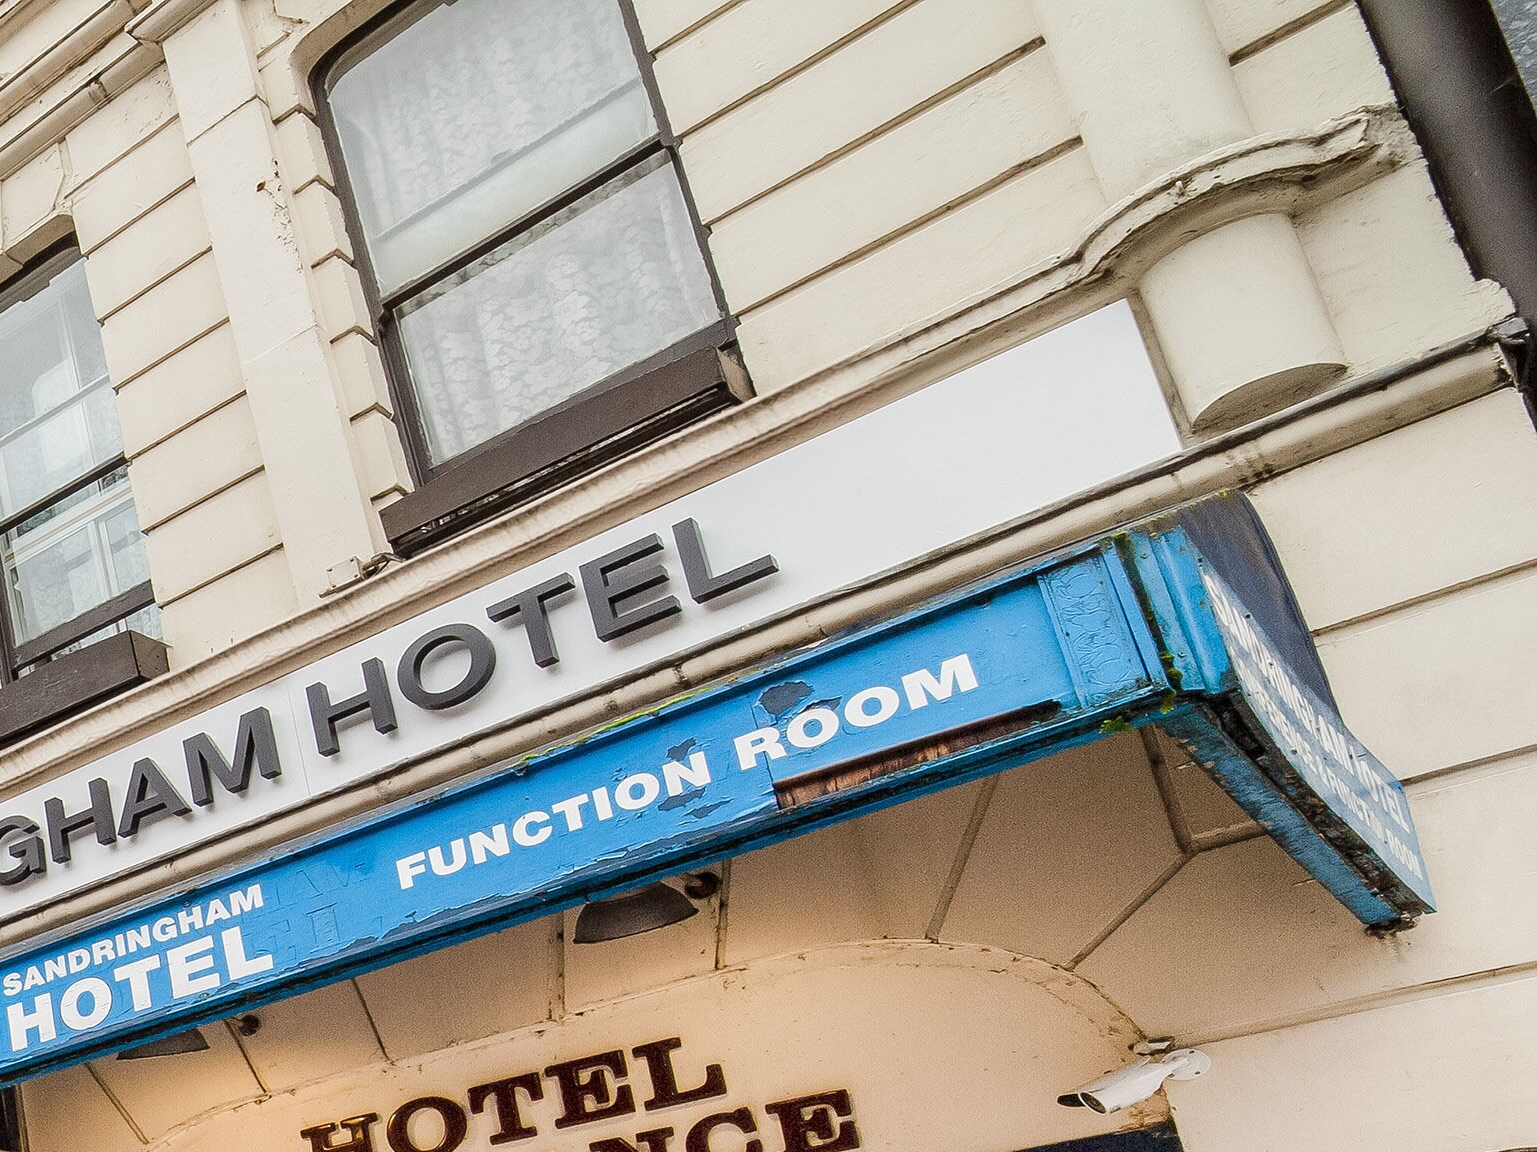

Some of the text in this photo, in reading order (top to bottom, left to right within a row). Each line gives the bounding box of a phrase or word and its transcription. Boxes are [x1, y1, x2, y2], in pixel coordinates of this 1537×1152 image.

[305, 518, 780, 759] HOTEL
[1205, 574, 1411, 834] SANDRINGHAM HOTEL
[395, 653, 979, 890] FUNCTION ROOM
[1386, 832, 1423, 881] ROOM
[2, 884, 265, 997] SANDRINGHAM
[6, 925, 274, 1052] HOTEL
